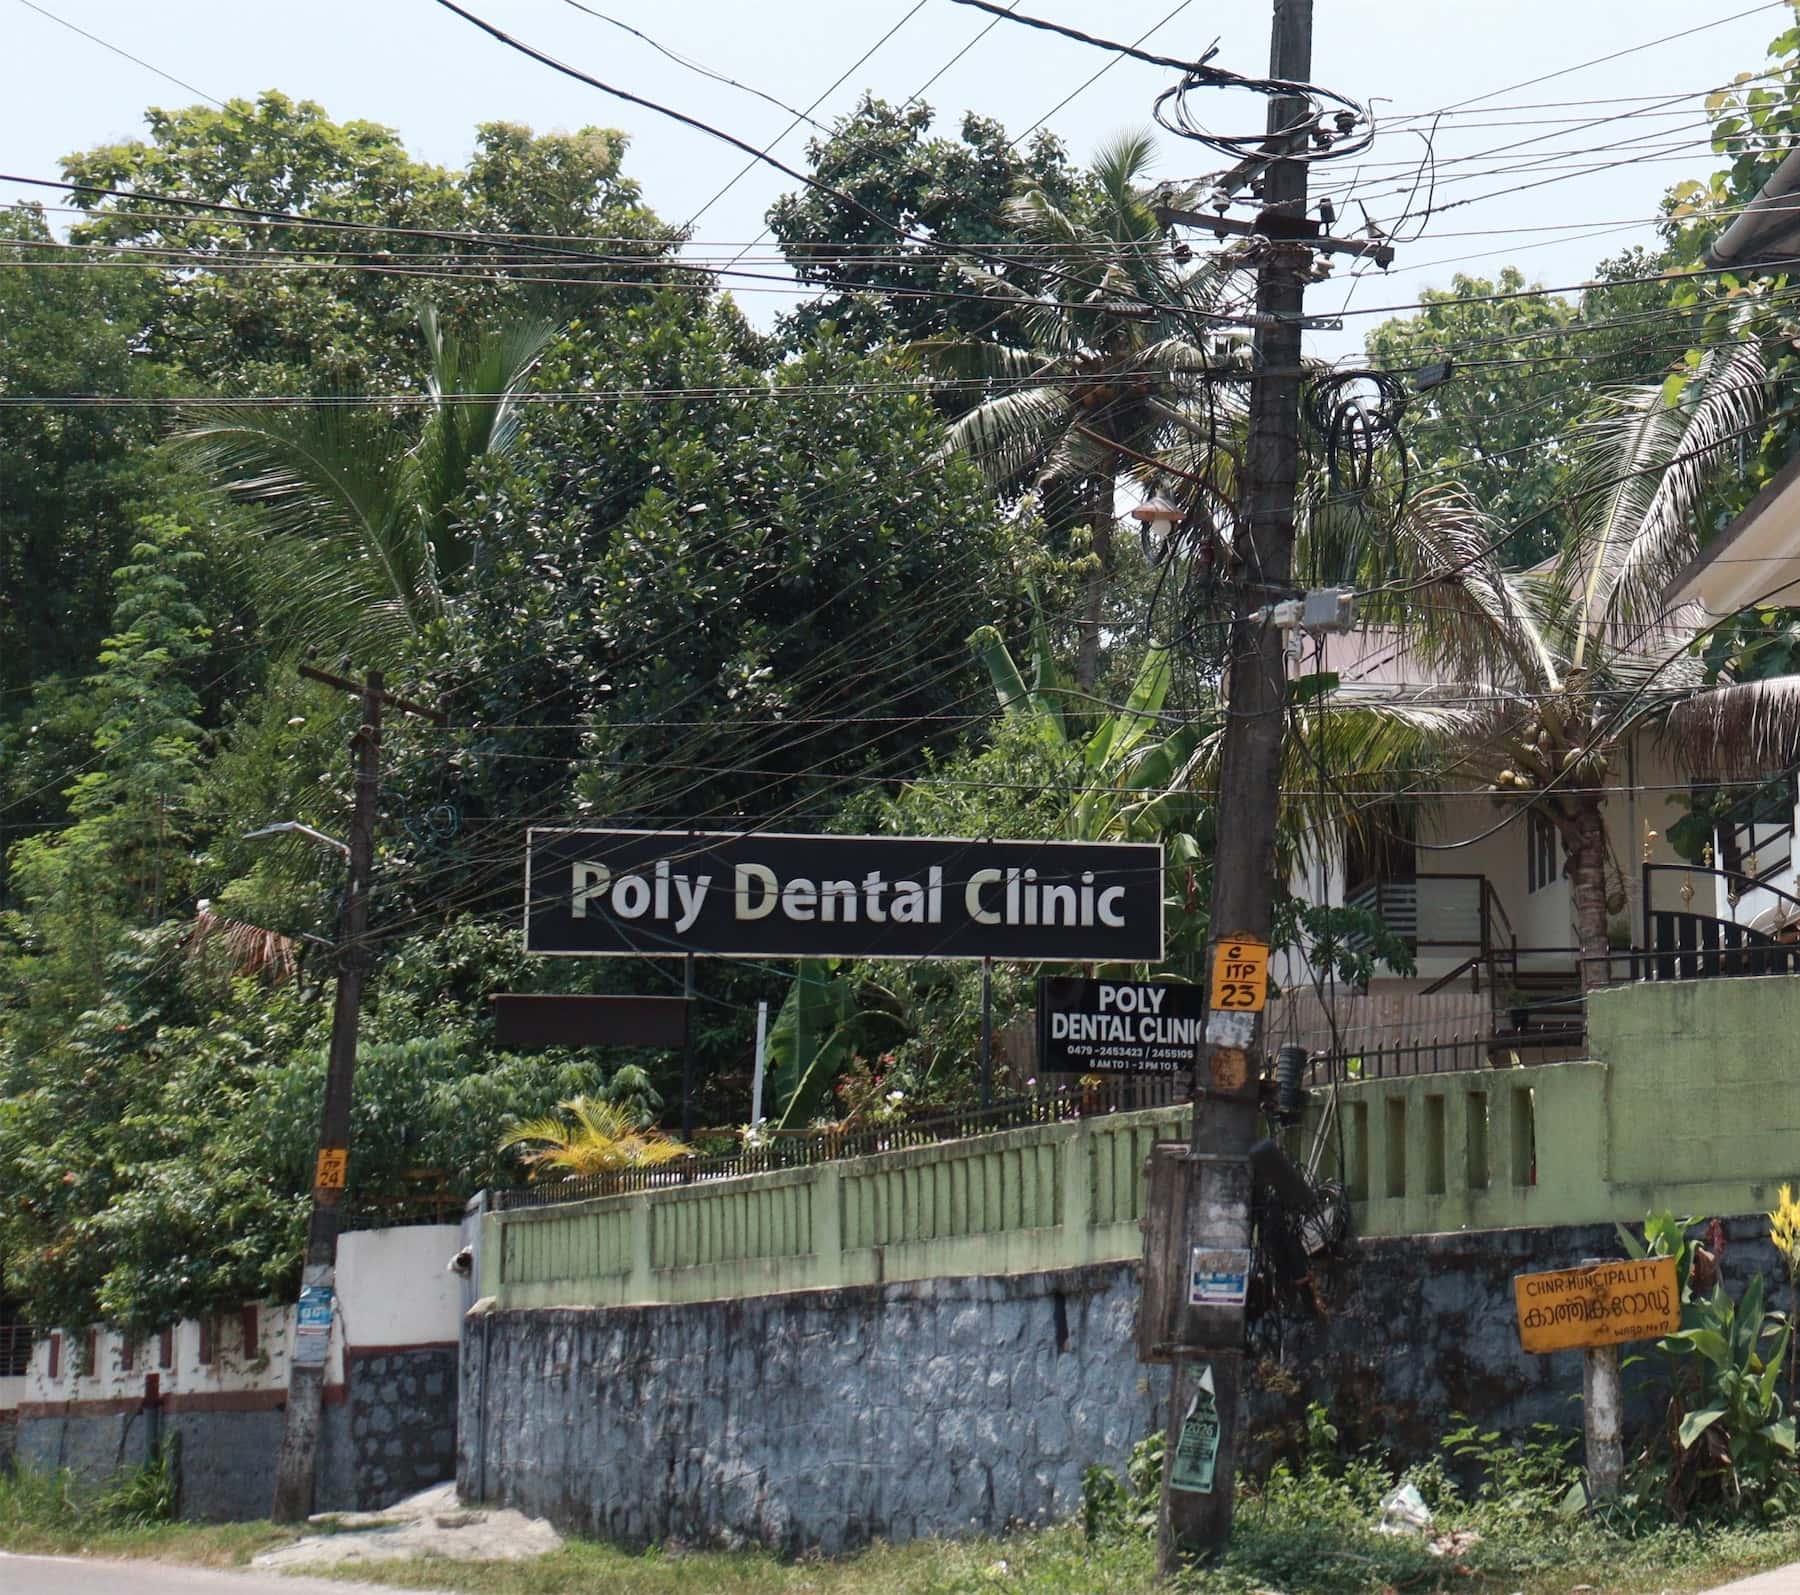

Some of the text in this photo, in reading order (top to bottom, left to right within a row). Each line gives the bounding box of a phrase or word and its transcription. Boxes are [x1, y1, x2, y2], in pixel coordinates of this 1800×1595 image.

[571, 860, 1126, 934] Poly Dental Clinic
[1226, 964, 1256, 979] ITP
[1099, 985, 1166, 1014] POLY
[1221, 984, 1256, 1007] 23
[1052, 1012, 1136, 1042] DENTAL
[1095, 1060, 1111, 1069] AM
[1112, 1061, 1125, 1069] TO
